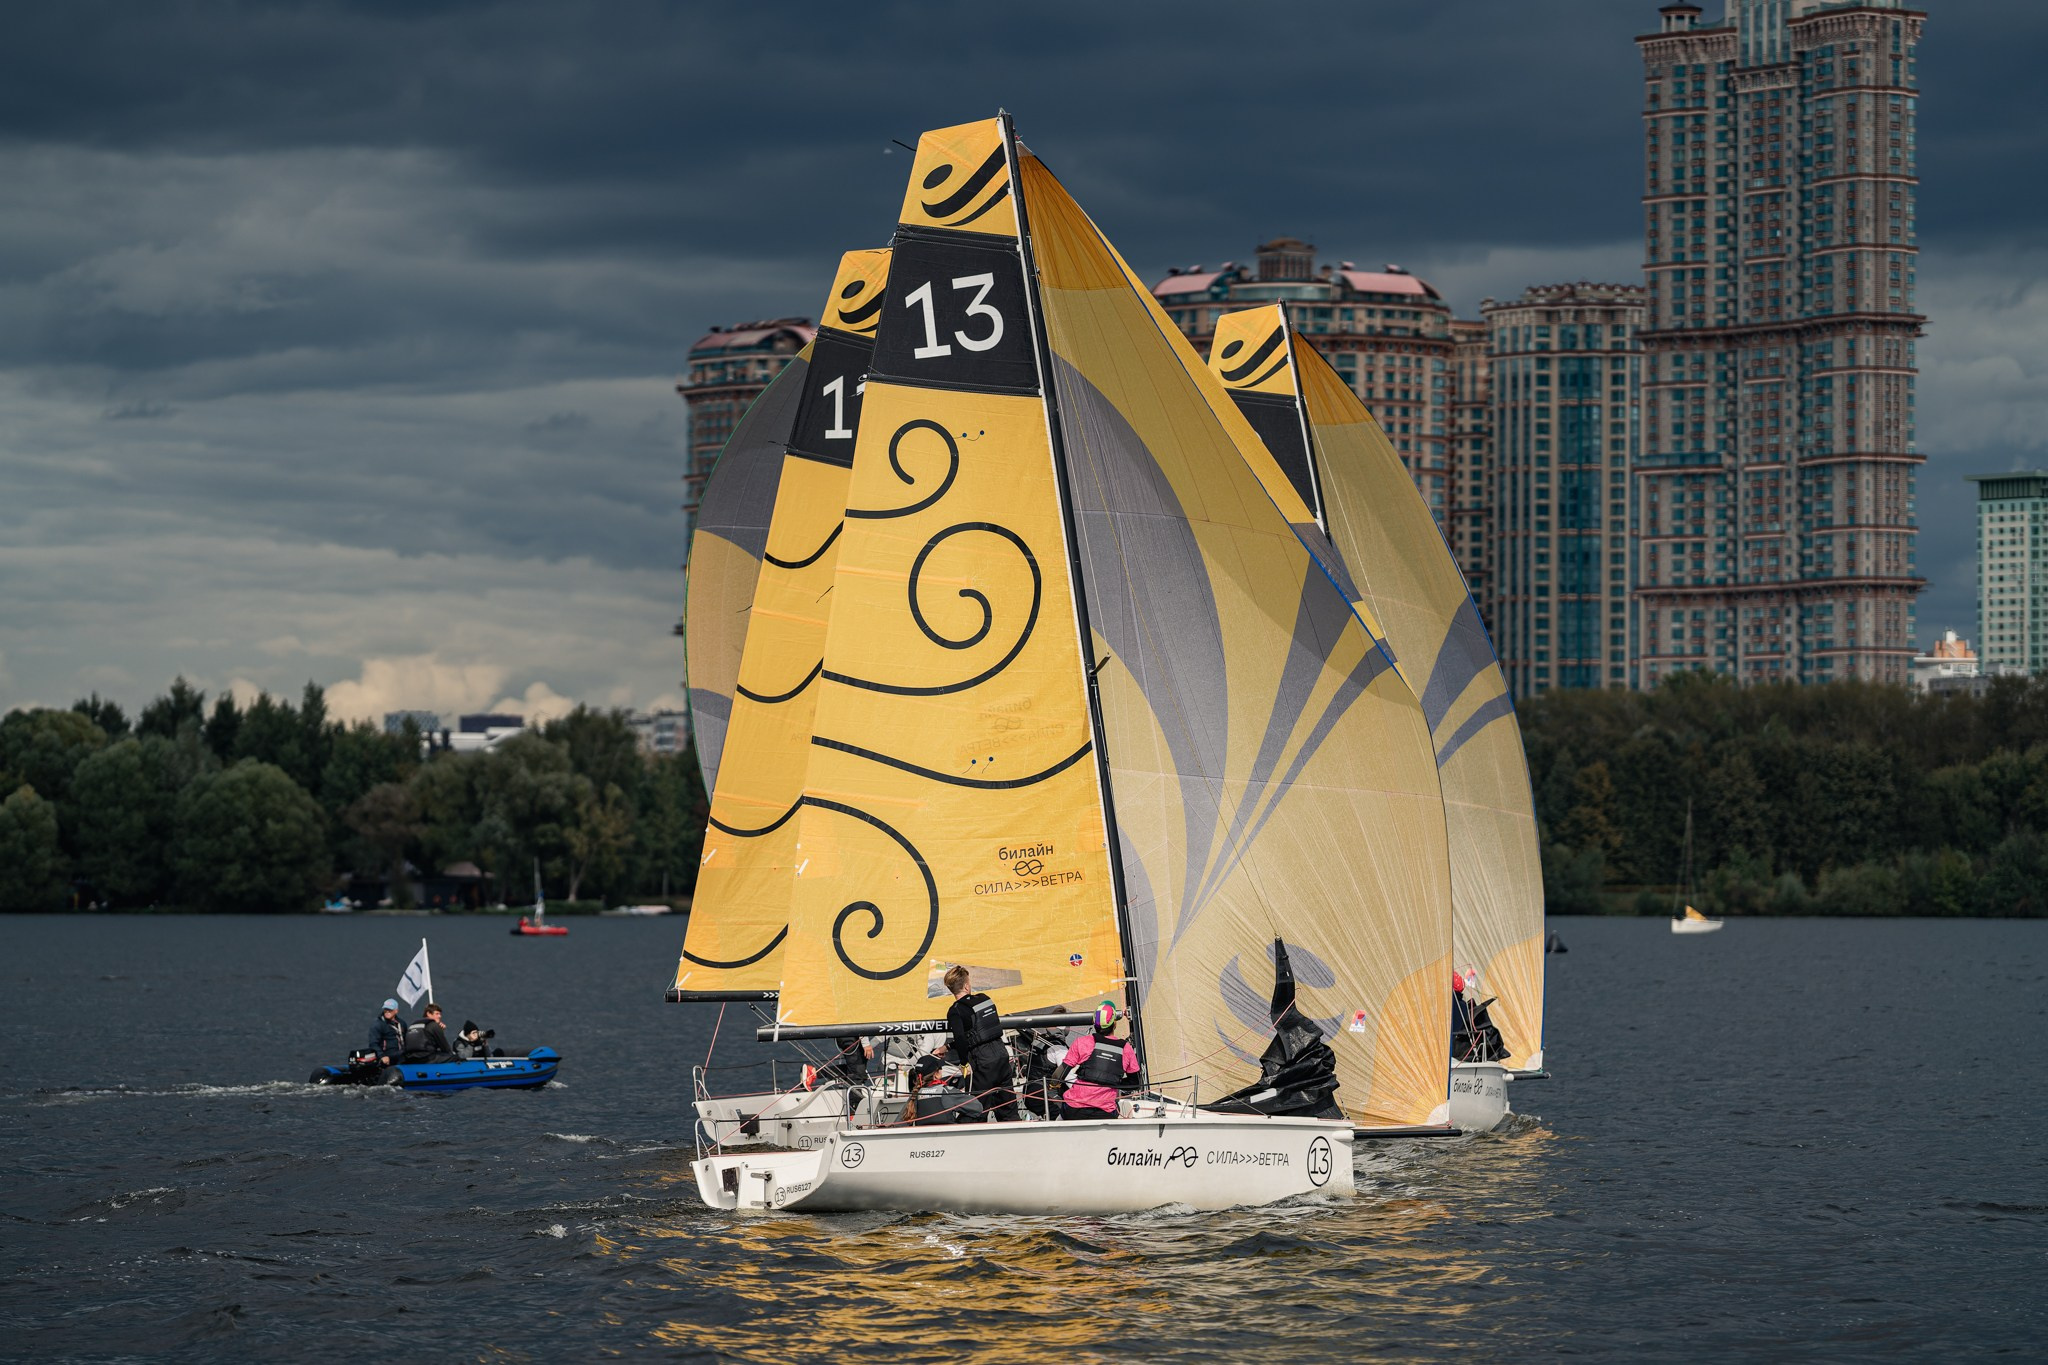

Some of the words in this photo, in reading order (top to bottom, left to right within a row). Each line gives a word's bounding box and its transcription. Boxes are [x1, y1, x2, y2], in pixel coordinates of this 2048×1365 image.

[905, 272, 1004, 359] 13
[998, 843, 1054, 861] билайн
[845, 1148, 862, 1162] 13
[909, 1149, 945, 1159] RUS6127
[1107, 1147, 1162, 1166] билайн
[1310, 1147, 1329, 1175] 13
[776, 1190, 785, 1202] 13
[786, 1181, 812, 1194] RUS6127
